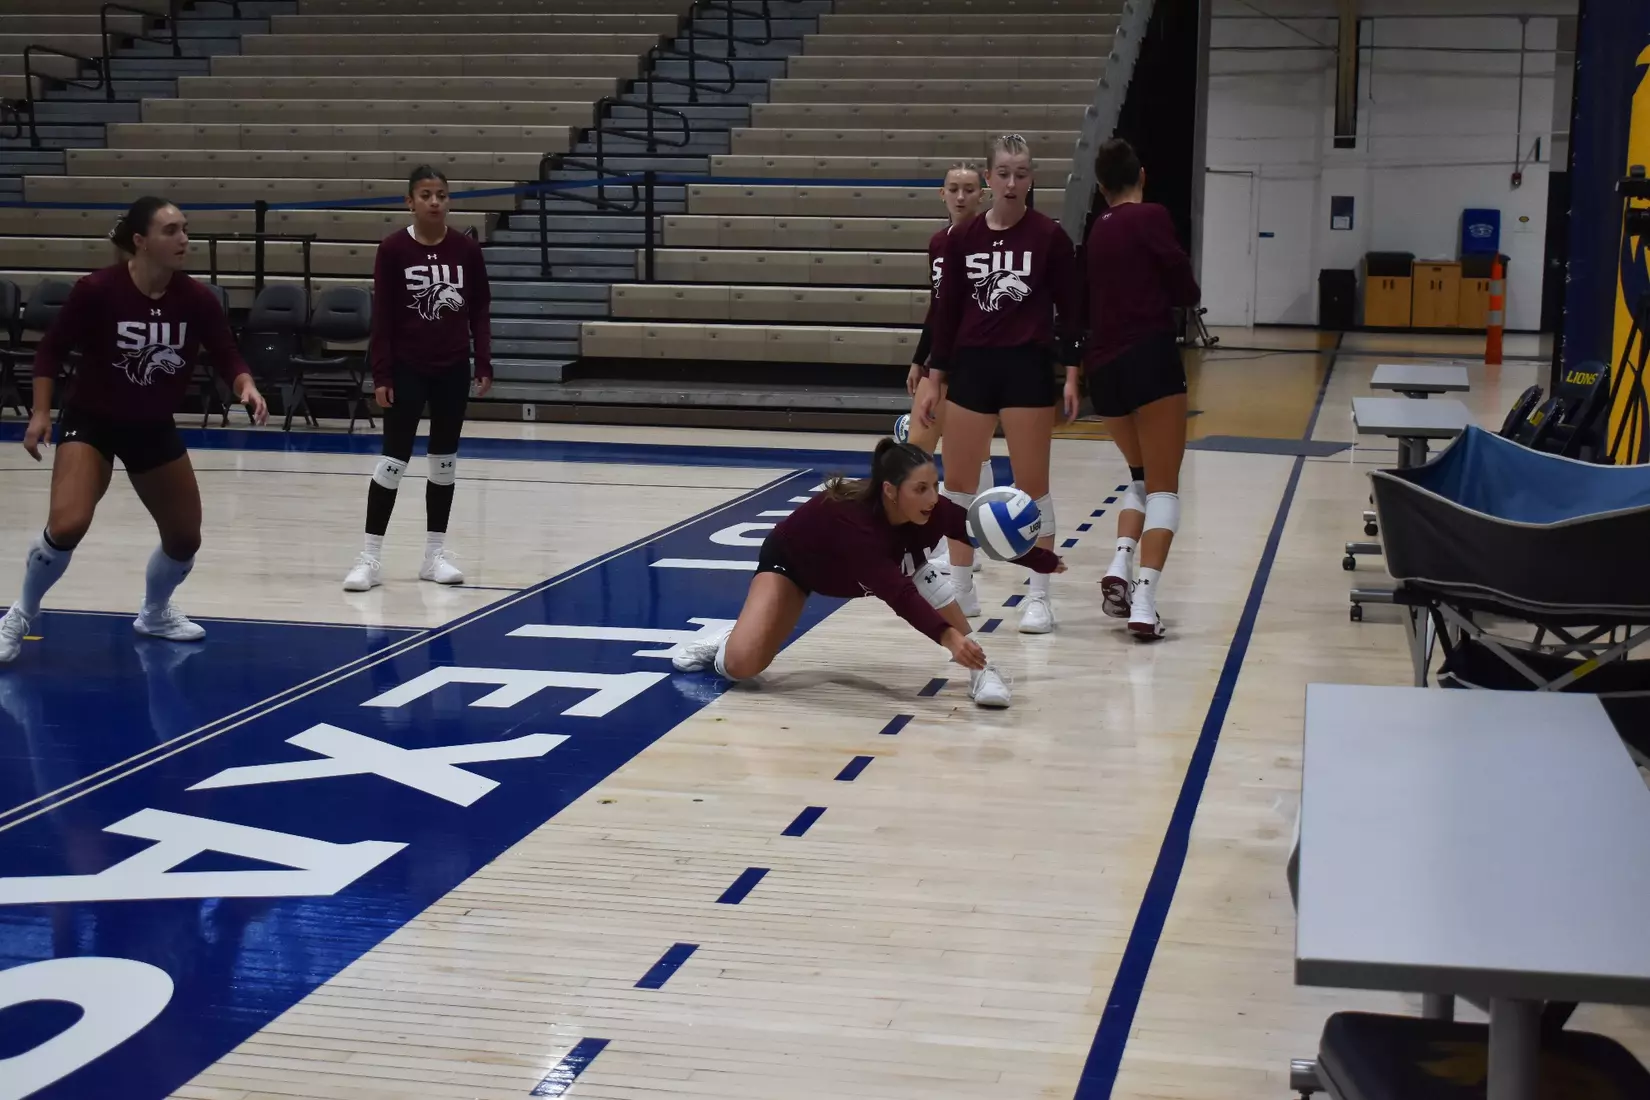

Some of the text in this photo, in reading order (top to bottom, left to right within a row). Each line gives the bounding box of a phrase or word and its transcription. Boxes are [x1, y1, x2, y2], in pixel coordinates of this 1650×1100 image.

[404, 264, 464, 290] SIU
[965, 251, 1032, 279] SIU
[117, 321, 187, 350] SIU
[1566, 370, 1599, 385] LIONS
